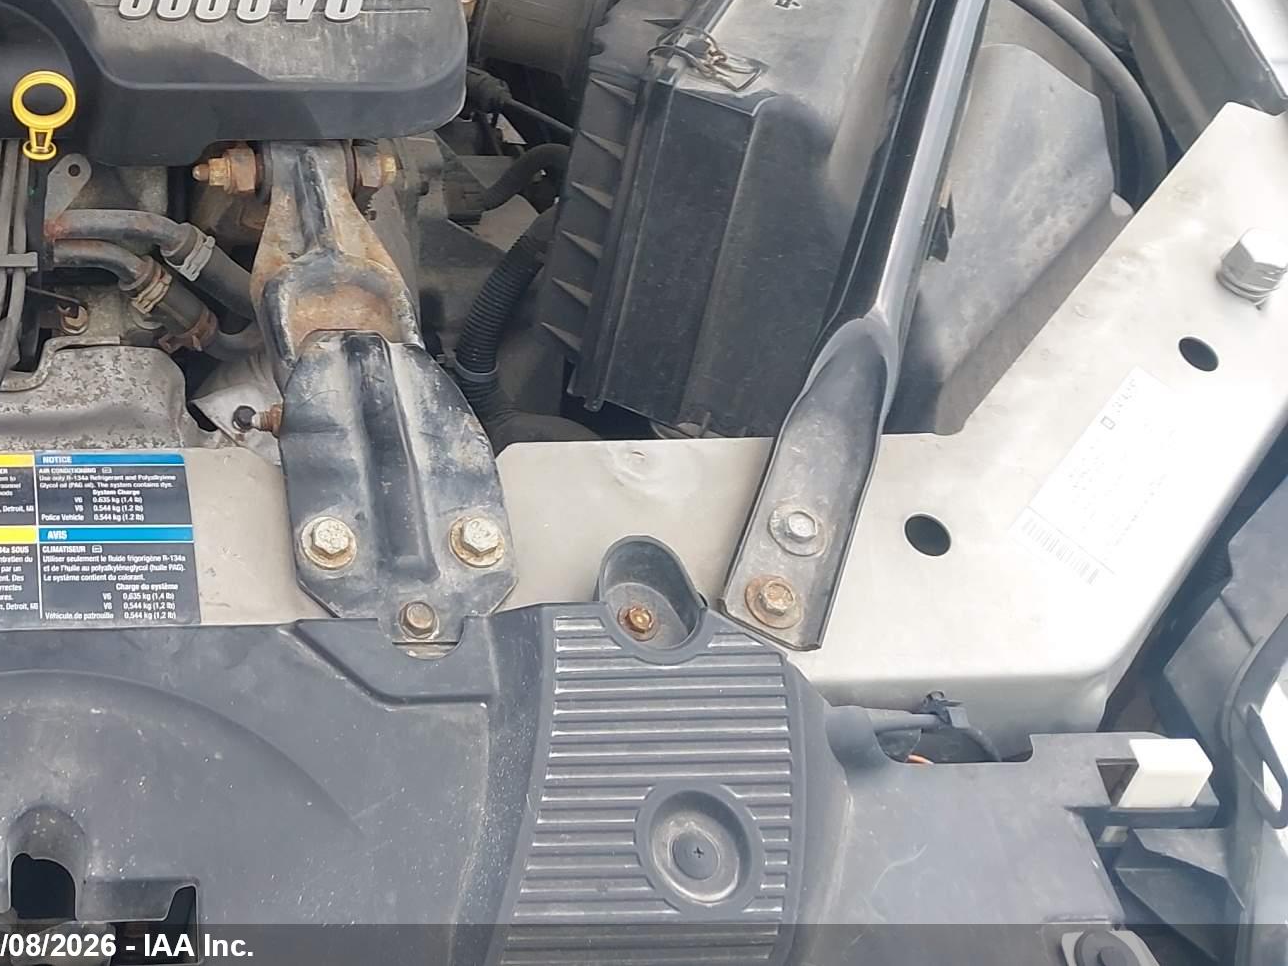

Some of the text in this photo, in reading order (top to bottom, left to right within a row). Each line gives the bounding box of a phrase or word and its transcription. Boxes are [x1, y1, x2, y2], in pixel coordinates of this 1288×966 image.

[48, 531, 67, 539] AVIS
[143, 593, 151, 601] kg
[143, 602, 151, 610] kg
[84, 612, 114, 620] patrouille
[144, 612, 152, 620] kg
